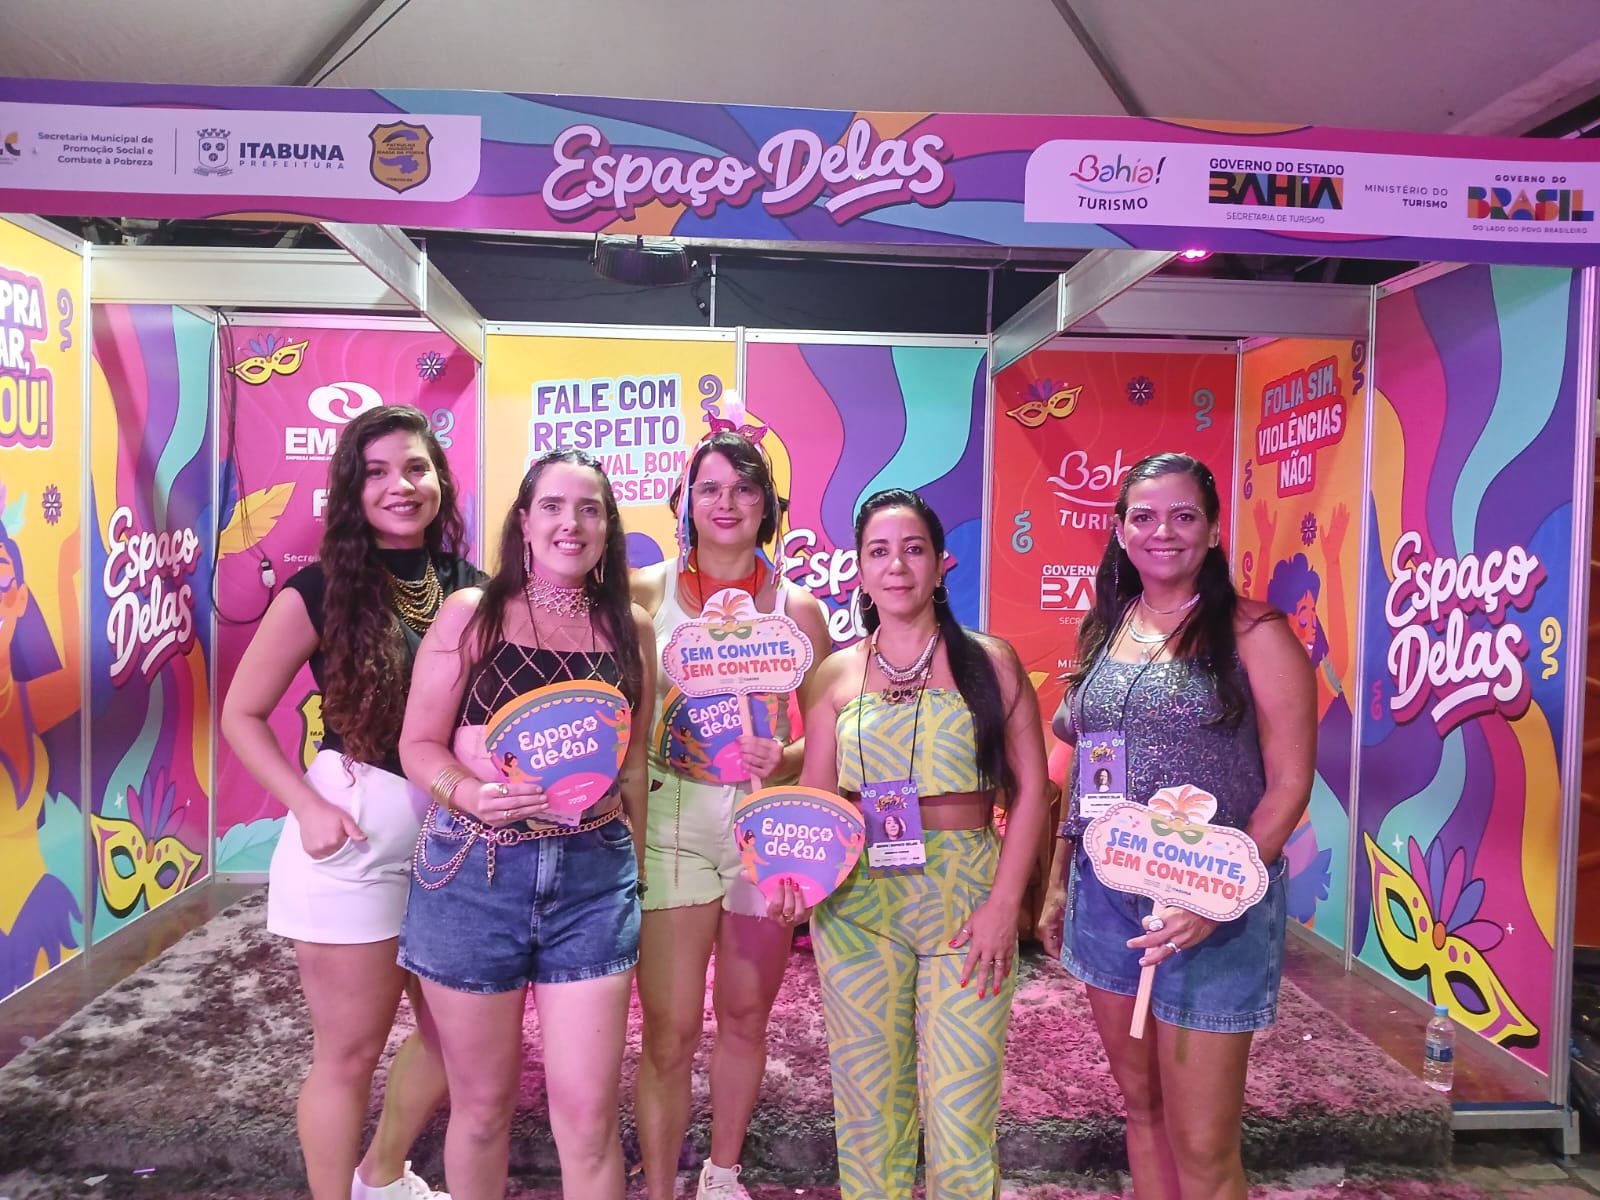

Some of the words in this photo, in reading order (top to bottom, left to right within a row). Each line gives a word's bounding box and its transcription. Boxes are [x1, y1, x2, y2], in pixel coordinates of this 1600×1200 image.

[38, 132, 88, 142] Secretaria
[91, 134, 138, 144] Municipal
[141, 136, 153, 144] de
[63, 144, 113, 155] Promoção
[116, 145, 145, 155] Social
[239, 142, 344, 161] ITABUNA
[58, 155, 102, 165] Combate
[113, 157, 153, 166] Pobreza
[239, 160, 344, 170] PREFEITURA
[542, 124, 756, 211] Espaço
[758, 118, 944, 205] Delas
[1209, 158, 1272, 172] GOVERNO
[1276, 161, 1294, 173] DO
[1297, 162, 1345, 176] ESTADO
[1209, 171, 1344, 210] BAHIA
[1364, 183, 1428, 196] MINISTÉRIO
[1432, 187, 1448, 196] DO
[1495, 174, 1546, 183] GOVERNO
[1077, 195, 1148, 211] TURISMO
[1402, 198, 1448, 209] TURISMO
[1467, 186, 1594, 222] BRASIL
[1226, 212, 1275, 222] SECRETARIA
[1276, 214, 1288, 222] DE
[1289, 215, 1325, 224] TURISMO
[537, 383, 609, 416] FALE
[619, 379, 676, 411] COM
[1264, 377, 1304, 417] FOLIA
[1307, 364, 1337, 401] SIM,
[534, 415, 680, 452] RESPEITO
[1258, 404, 1342, 457] VIOLÊNCIAS
[644, 450, 686, 474] BOM
[1280, 449, 1312, 489] NÃO!
[611, 473, 682, 503] SSÉDI
[1059, 509, 1113, 530] TURI
[104, 506, 199, 598] Espaço
[1385, 531, 1539, 628] Espaço
[107, 574, 192, 677] Delas
[680, 647, 714, 665] SEM
[717, 641, 796, 659] CONVITE,
[1387, 608, 1523, 710] Delas
[682, 663, 714, 681] SEM
[717, 657, 797, 676] CONTATO!
[518, 715, 598, 752] Espaço
[530, 737, 599, 770] delas
[761, 817, 834, 844] Espaço
[764, 838, 827, 861] delas
[1106, 828, 1148, 853] SEM
[1153, 841, 1247, 885] CONVITE,
[1102, 847, 1141, 872] SEM
[1146, 860, 1245, 902] CONTATO!
